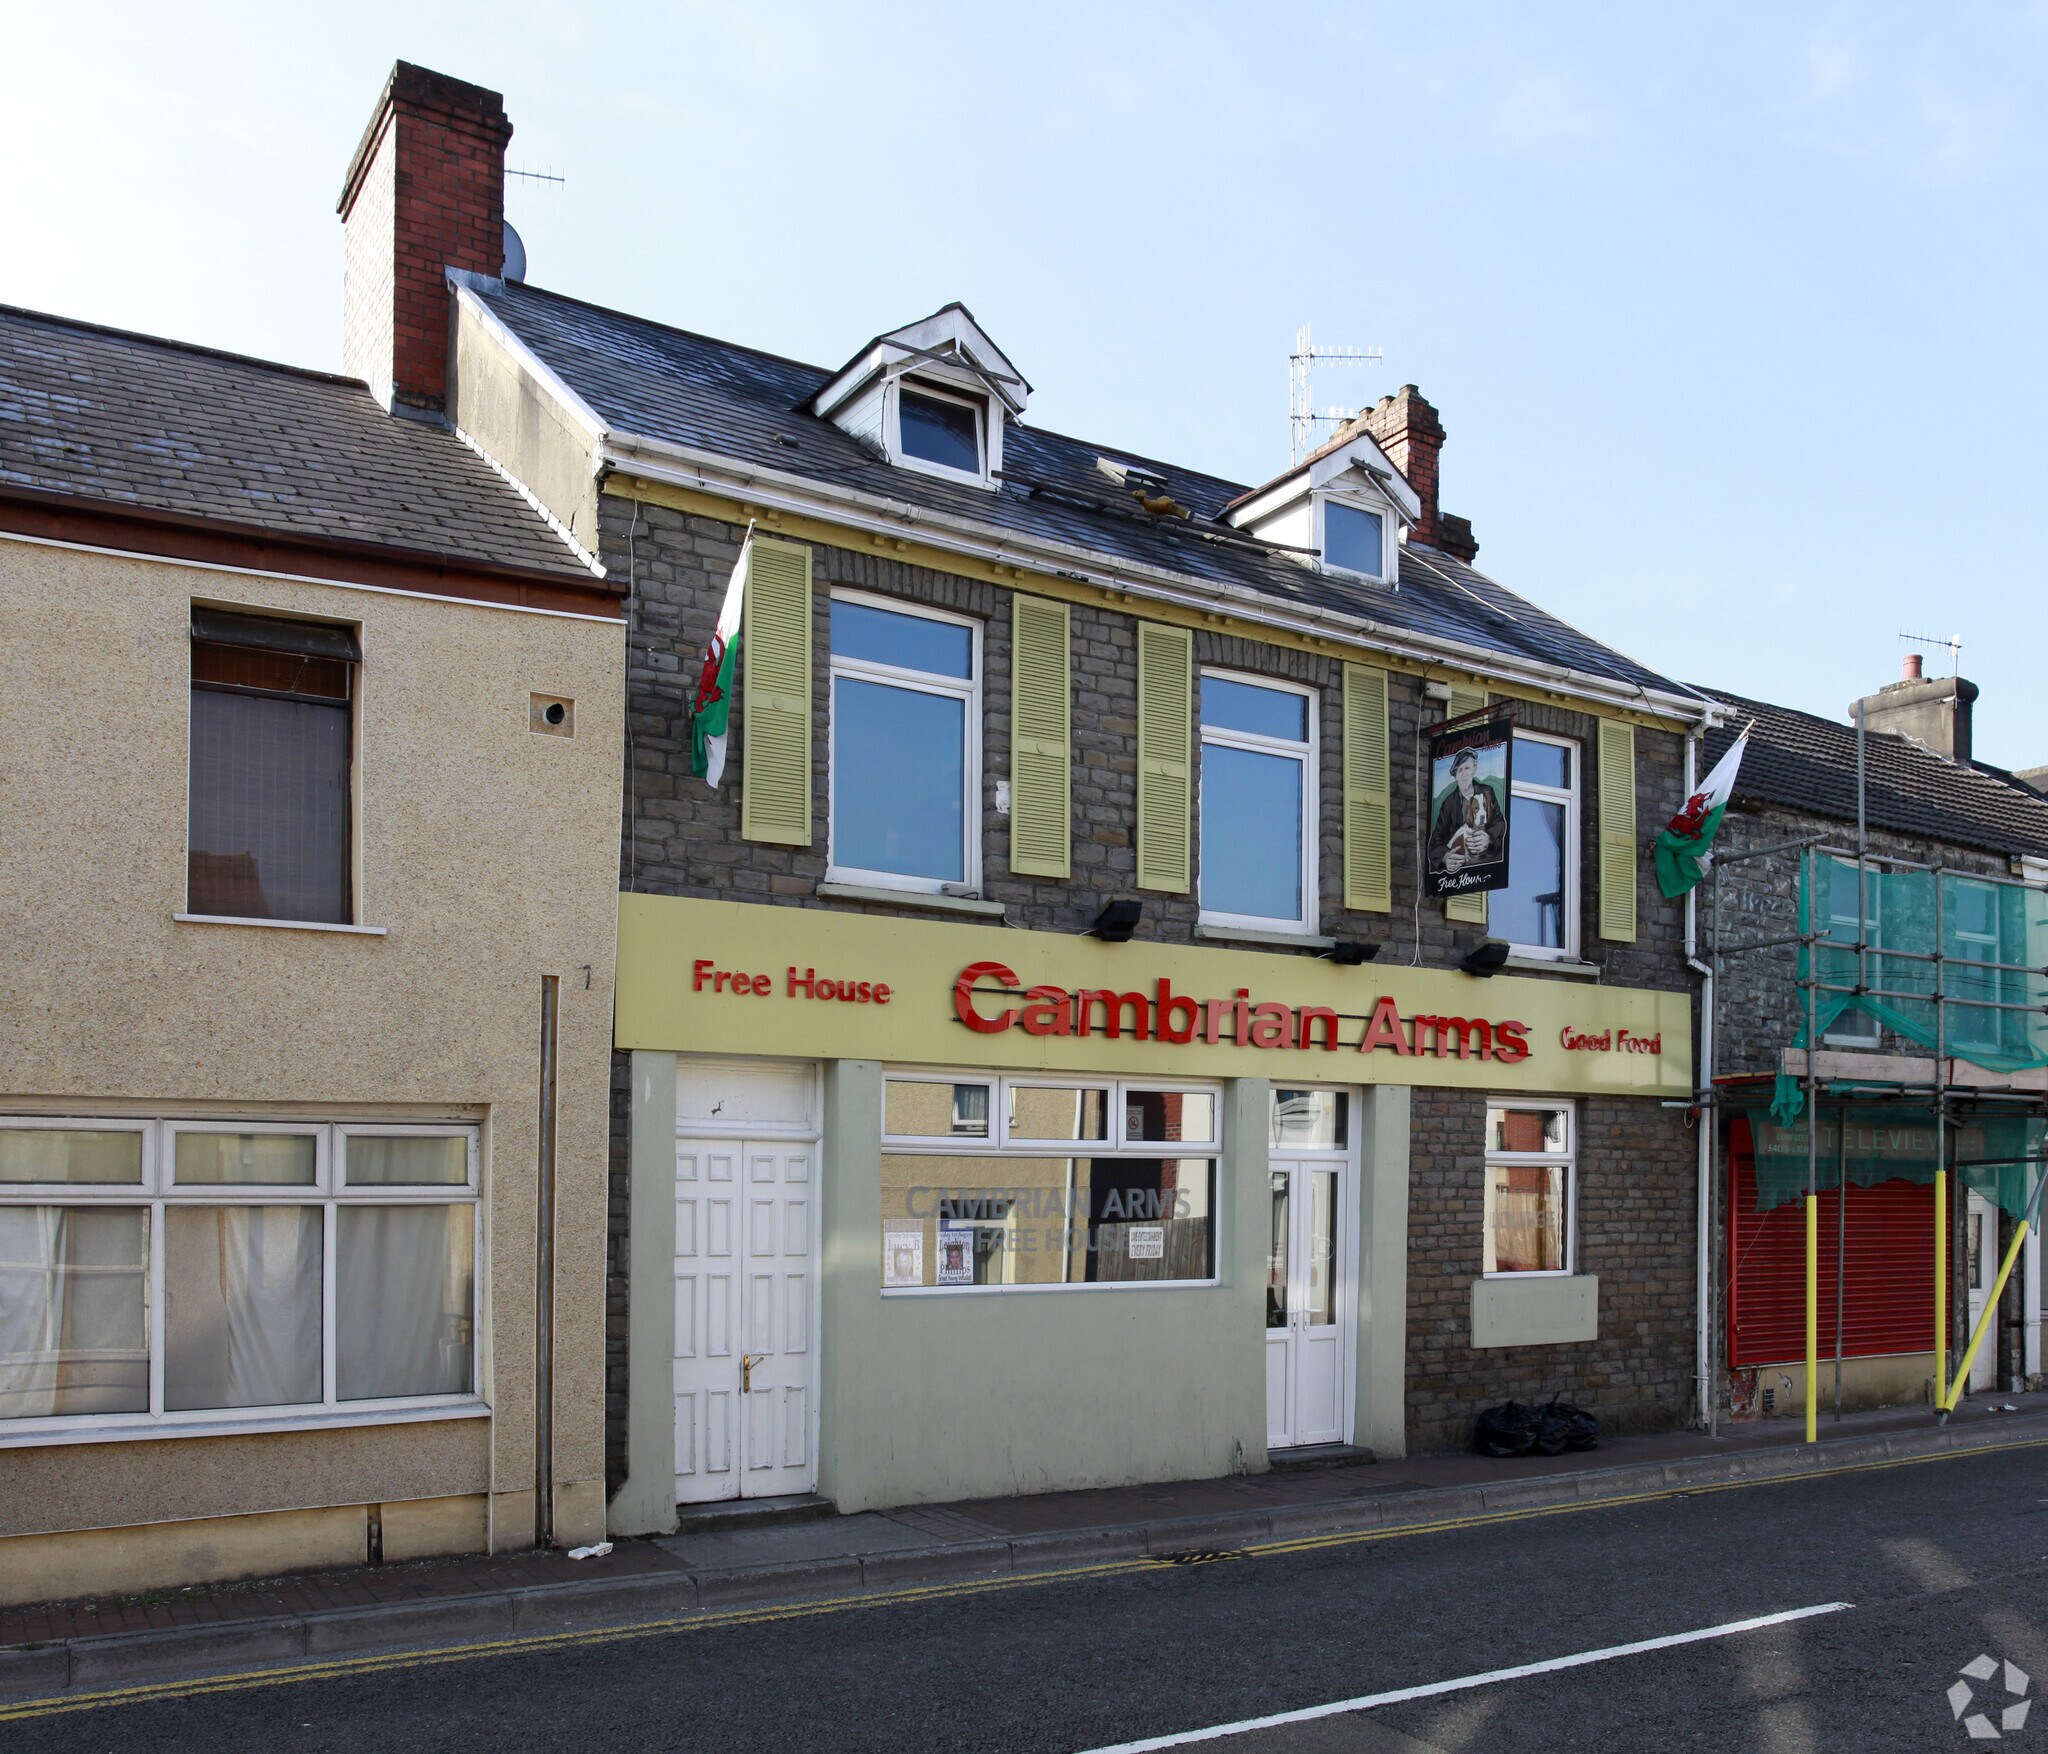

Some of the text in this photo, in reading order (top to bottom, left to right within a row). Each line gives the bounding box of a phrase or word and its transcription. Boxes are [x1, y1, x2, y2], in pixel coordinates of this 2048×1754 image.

[1437, 876, 1458, 892] Free
[693, 960, 891, 1004] Free House
[953, 961, 1529, 1064] Cambrian Arms
[1561, 1025, 1662, 1055] Good Food
[905, 1186, 1191, 1219] CAMBRIAN ARMS
[1489, 1211, 1554, 1229] LOUNGE
[976, 1228, 1131, 1252] FREE HOUSE
